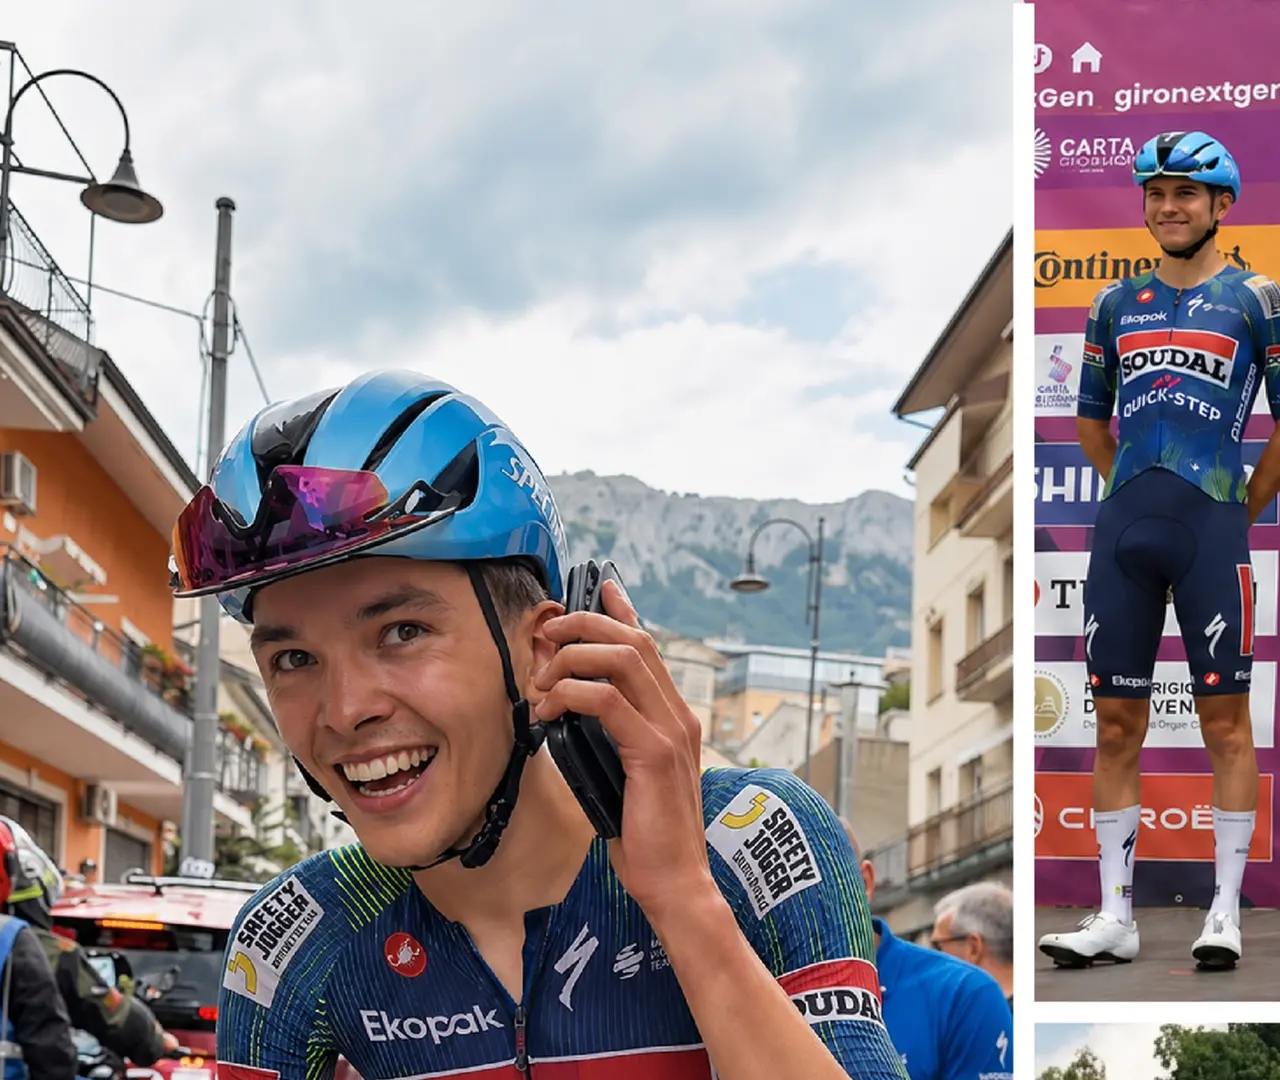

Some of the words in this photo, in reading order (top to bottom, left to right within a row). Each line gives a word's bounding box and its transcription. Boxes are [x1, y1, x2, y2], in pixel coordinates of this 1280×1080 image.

[1060, 138, 1135, 157] CARTA
[1121, 348, 1226, 383] SOUDAL
[1035, 466, 1106, 502] HI
[1059, 804, 1214, 830] CIROË
[762, 806, 816, 885] SAFETY
[237, 880, 297, 949] SAFETY
[359, 1004, 505, 1046] Ekopak
